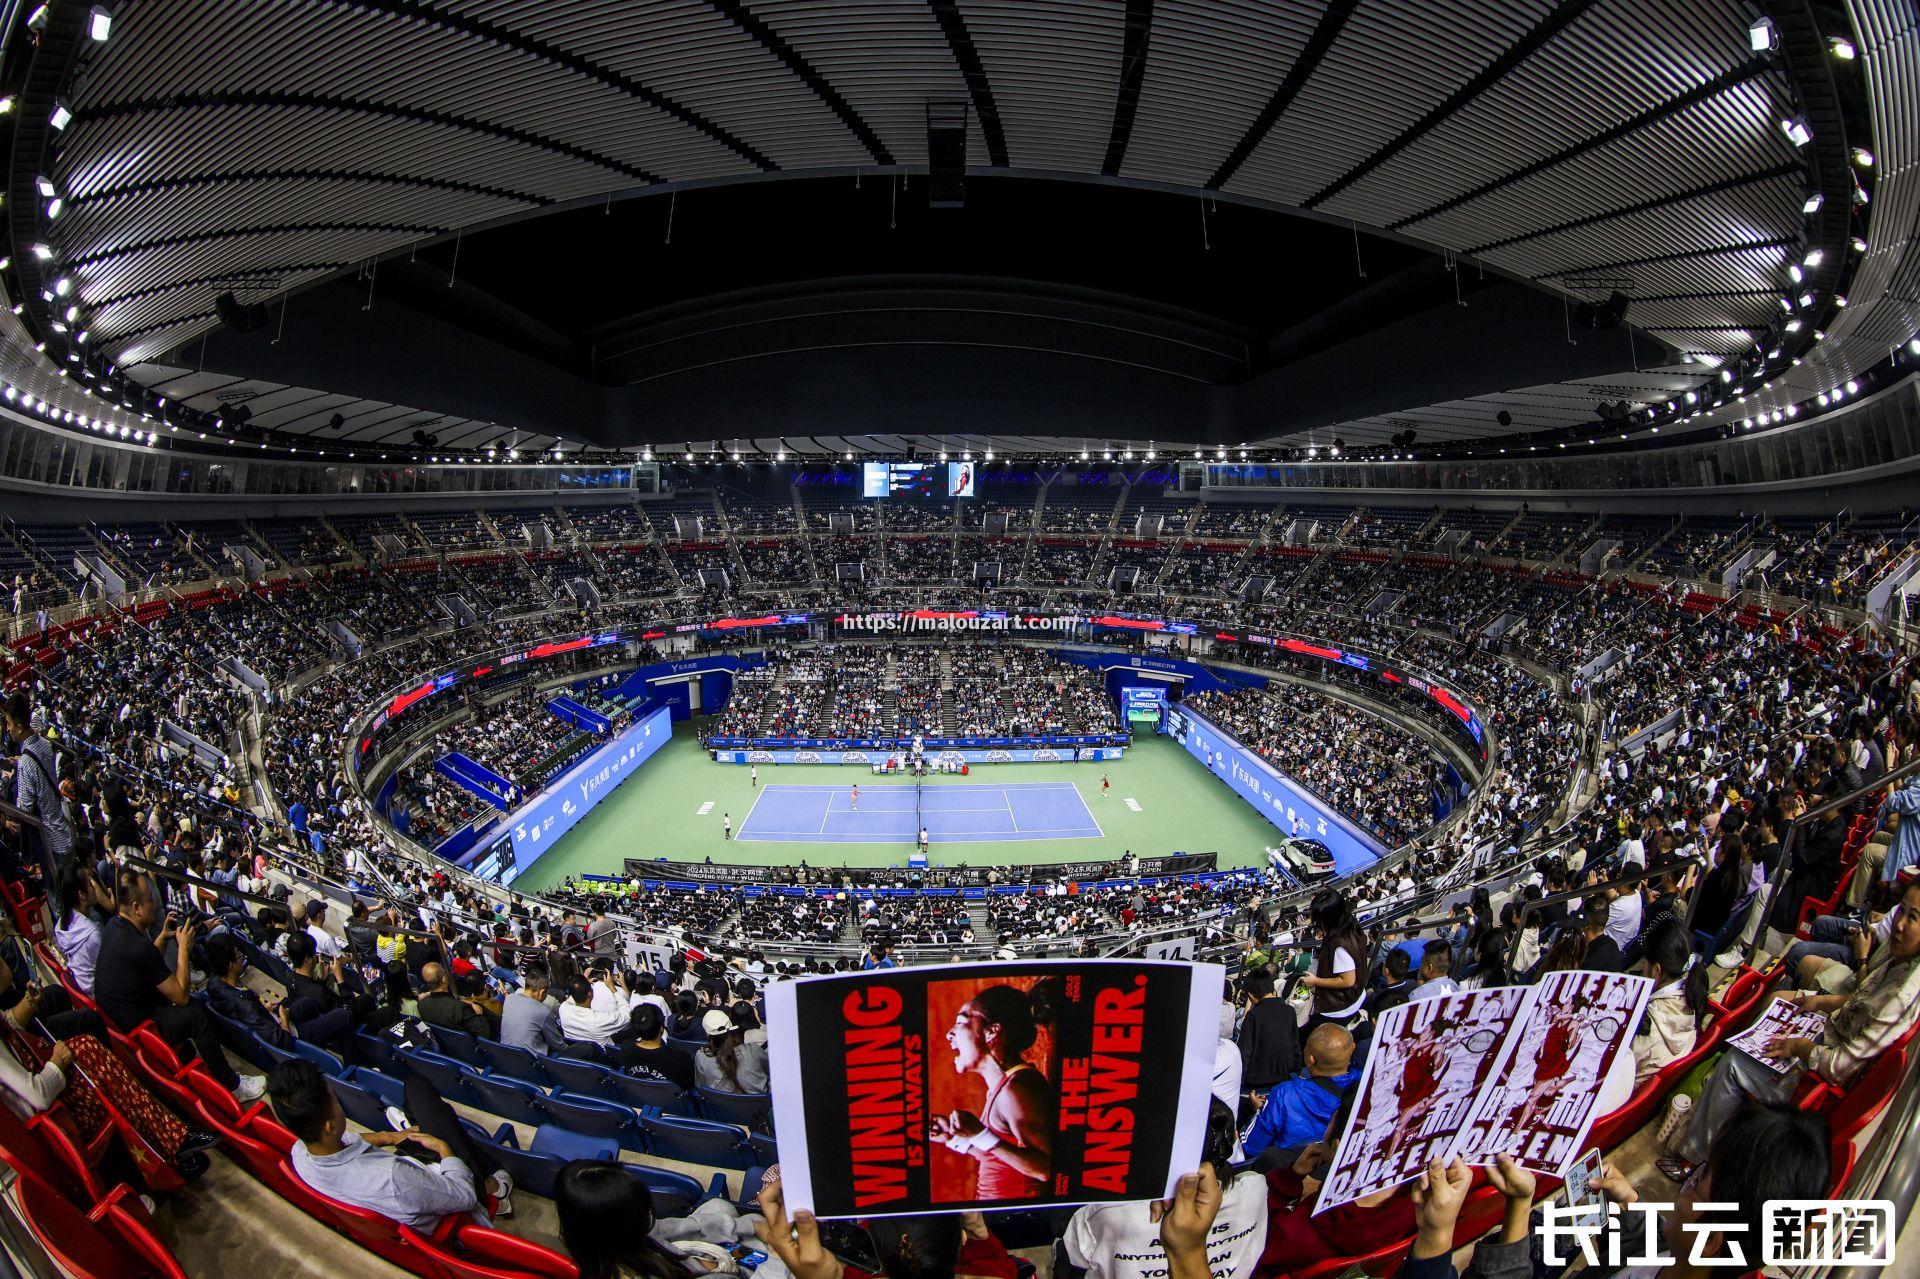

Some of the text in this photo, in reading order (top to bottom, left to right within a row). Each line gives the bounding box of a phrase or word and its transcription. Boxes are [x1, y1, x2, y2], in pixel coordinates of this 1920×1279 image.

[1238, 767, 1260, 795] 东风岚图
[638, 950, 664, 971] 15
[1539, 973, 1646, 1011] QUEEN
[1382, 988, 1526, 1043] QUEEN
[842, 985, 908, 1208] WINNING
[904, 1034, 924, 1167] IS ALWAYS
[1060, 1057, 1089, 1132] THE
[1082, 974, 1148, 1194] ANSWER.
[1206, 1222, 1257, 1248] NYTHING
[1211, 1222, 1230, 1235] IS
